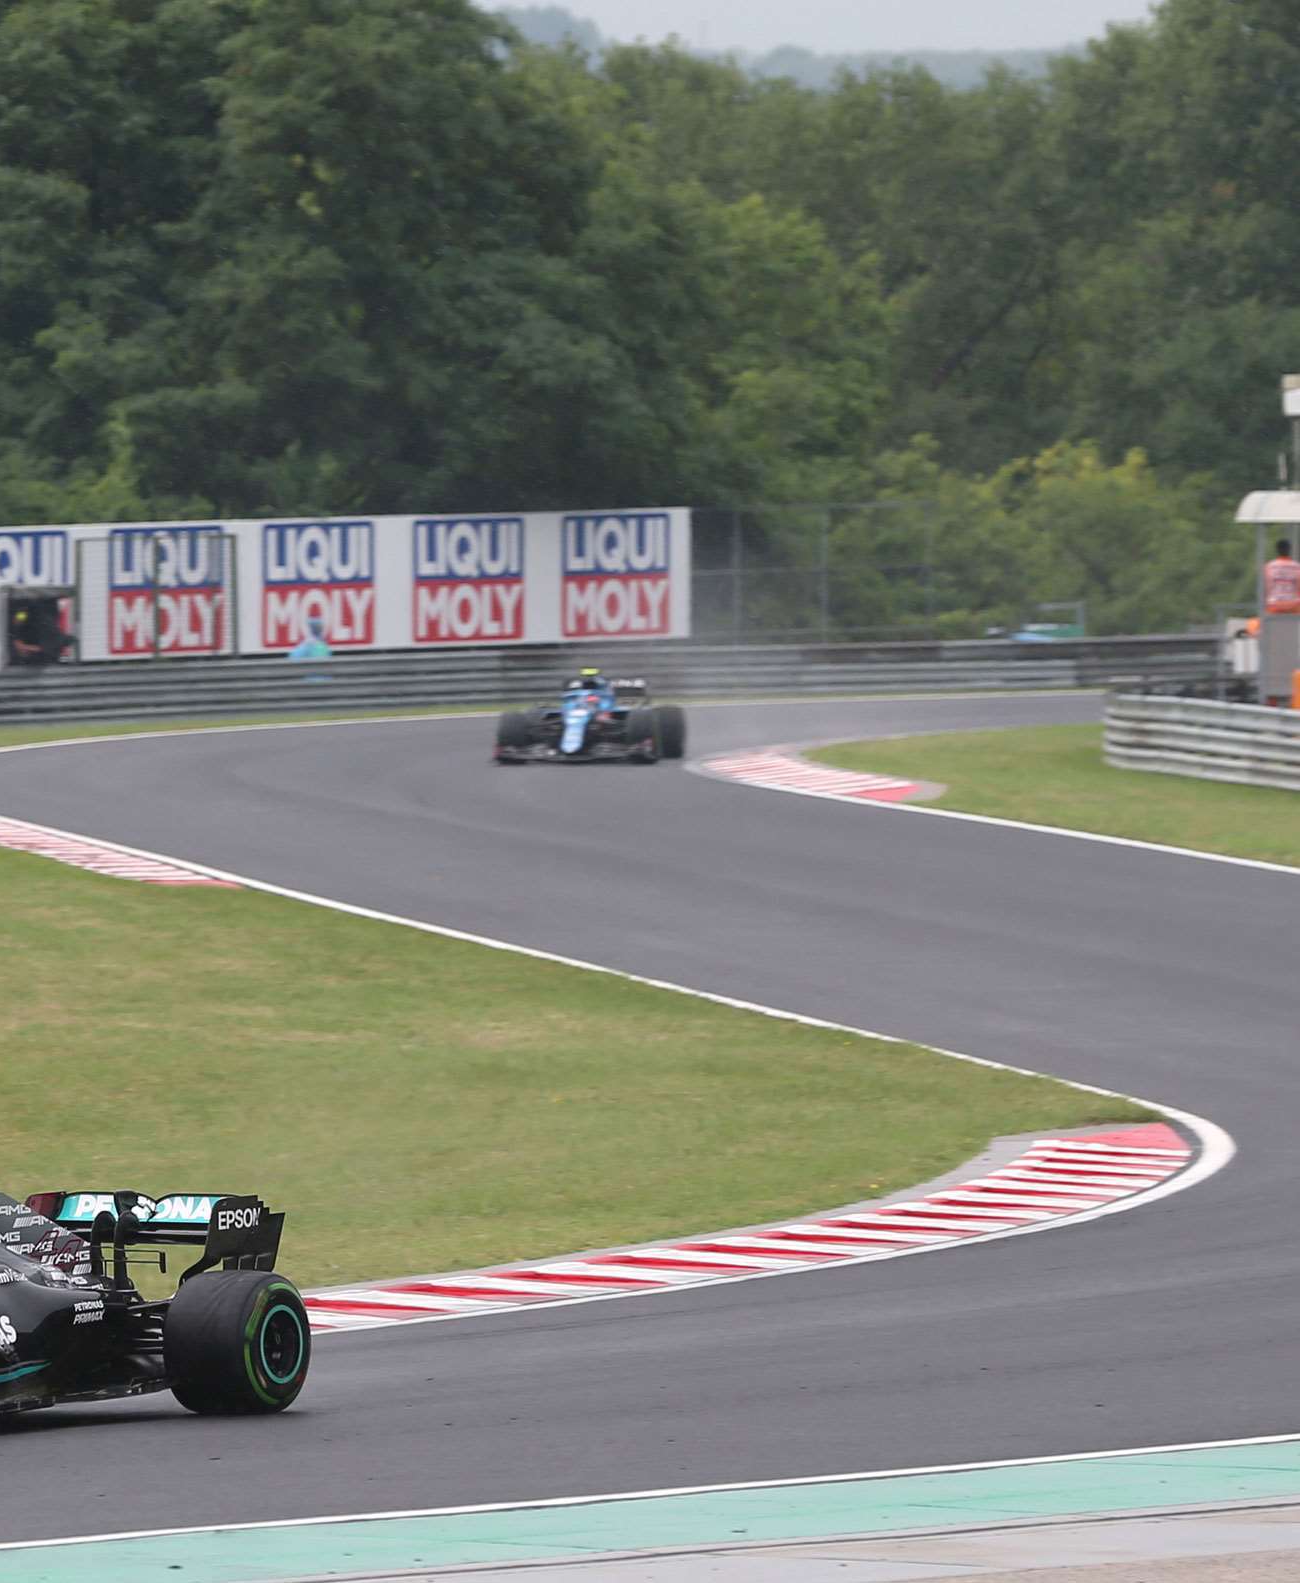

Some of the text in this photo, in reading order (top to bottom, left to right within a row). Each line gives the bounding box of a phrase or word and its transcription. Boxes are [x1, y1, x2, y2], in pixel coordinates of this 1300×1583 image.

[113, 532, 220, 584] LIQUI
[267, 526, 370, 582] LIQUI
[417, 521, 520, 578] LIQUI
[566, 516, 666, 573] LIQUI
[113, 594, 224, 651] MOLY
[267, 588, 373, 645] MOLY
[417, 583, 523, 638] MOLY
[566, 577, 670, 634] MOLY
[217, 1208, 261, 1231] EPSON
[74, 1300, 104, 1312] PETRONAS
